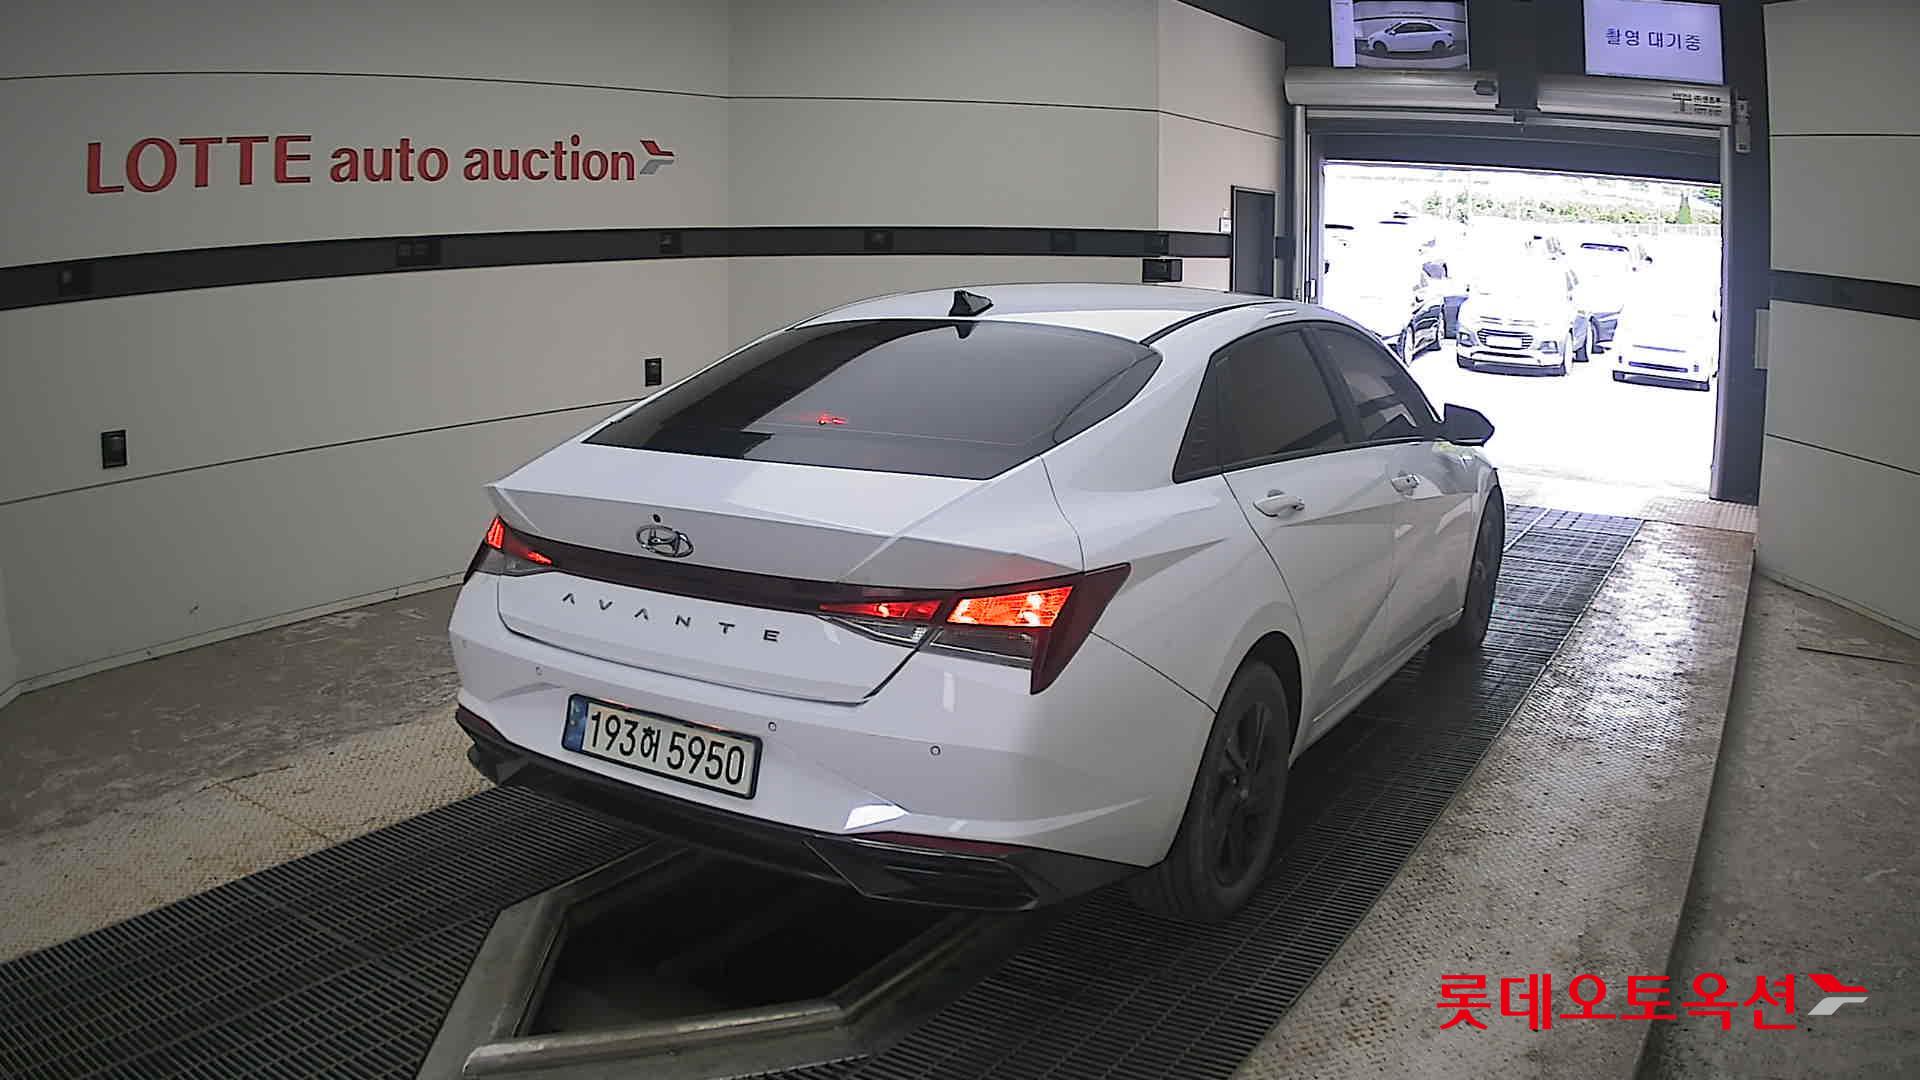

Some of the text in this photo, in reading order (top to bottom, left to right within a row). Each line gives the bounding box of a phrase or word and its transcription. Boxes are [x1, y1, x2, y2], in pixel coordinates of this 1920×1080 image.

[1648, 31, 1701, 51] 대기중
[86, 134, 635, 194] LOTTE auto auction
[562, 592, 780, 642] AVANTE
[590, 711, 745, 785] 193허 5950
